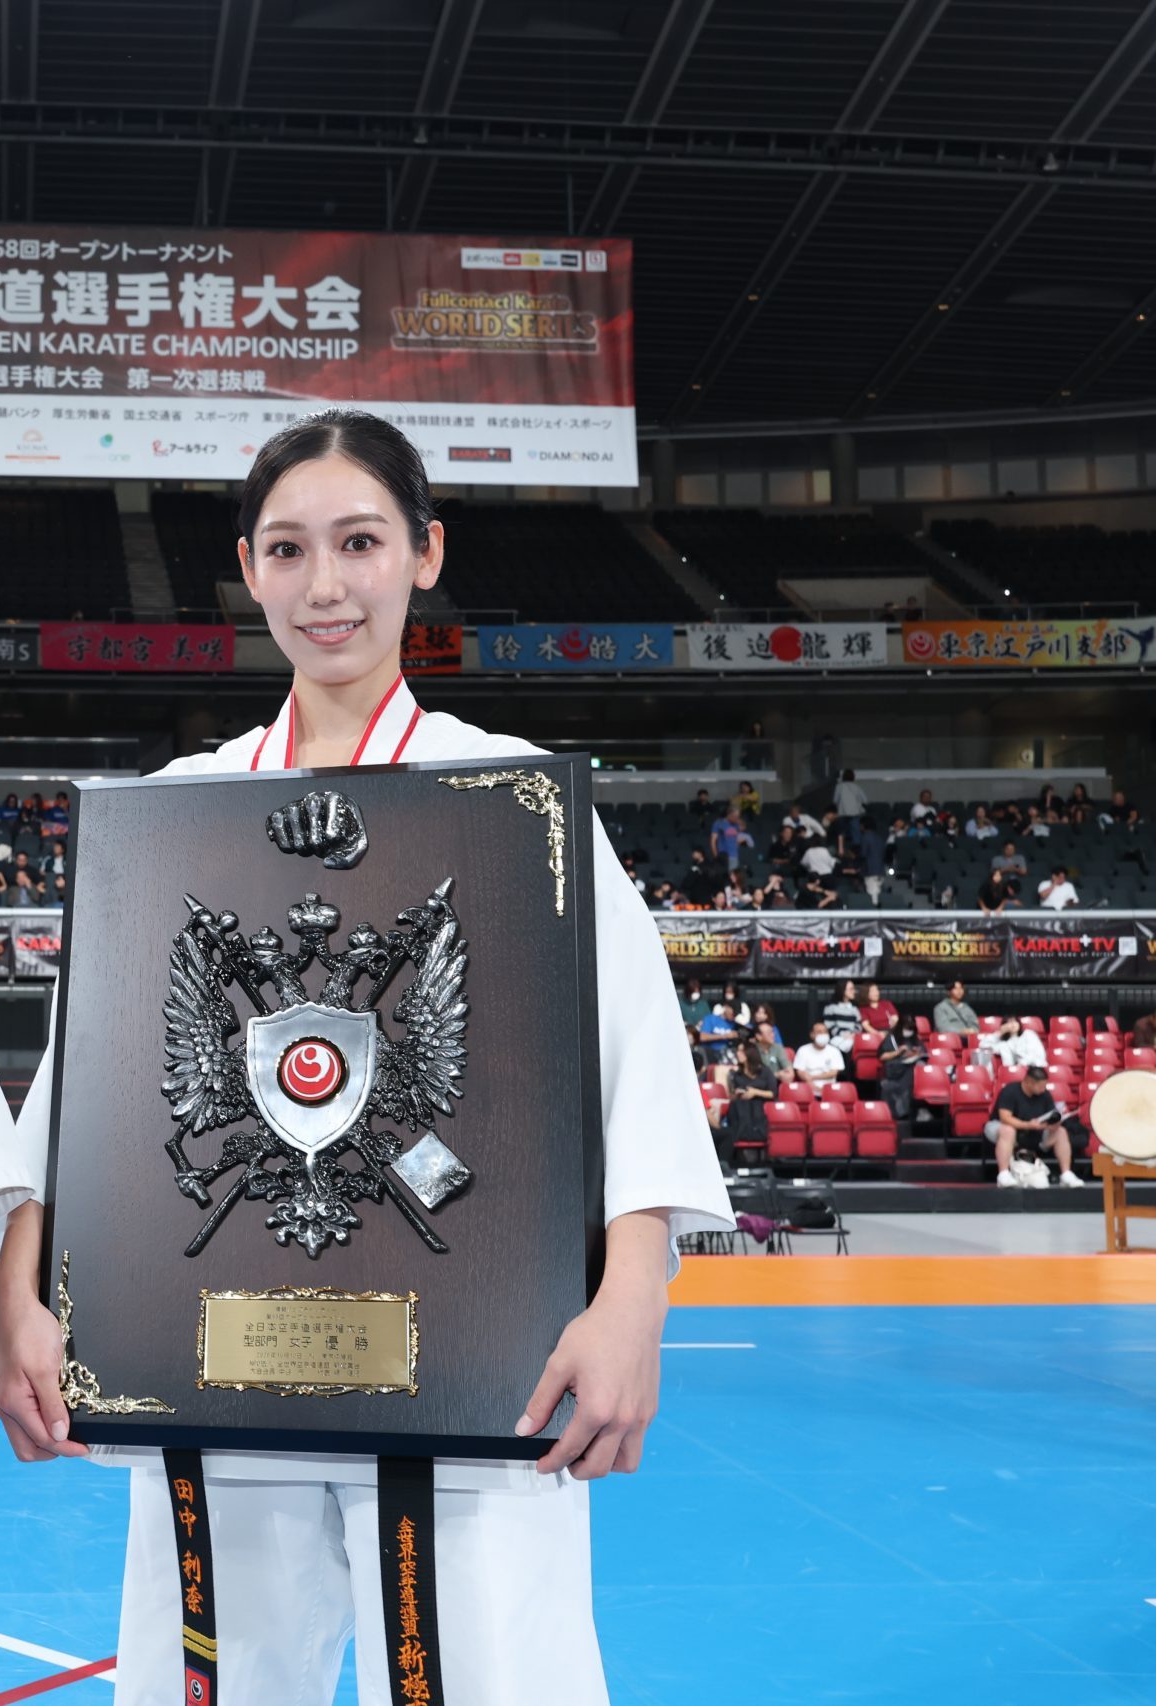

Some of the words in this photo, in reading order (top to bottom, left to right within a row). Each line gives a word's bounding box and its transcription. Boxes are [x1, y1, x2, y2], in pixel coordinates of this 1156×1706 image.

[396, 310, 501, 337] WORLD
[505, 313, 597, 339] SERIES
[39, 331, 146, 356] KARATE
[152, 334, 360, 360] CHAMPIONSHIP
[127, 366, 268, 393] 第一次選抜戦
[938, 632, 1127, 661] 東京江戸川支部
[16, 936, 62, 951] KARA
[662, 941, 700, 956] ORLD
[760, 938, 828, 953] KARATE
[893, 940, 952, 956] WORLD
[952, 940, 1001, 957] SERIES
[1014, 936, 1081, 952] KARATE
